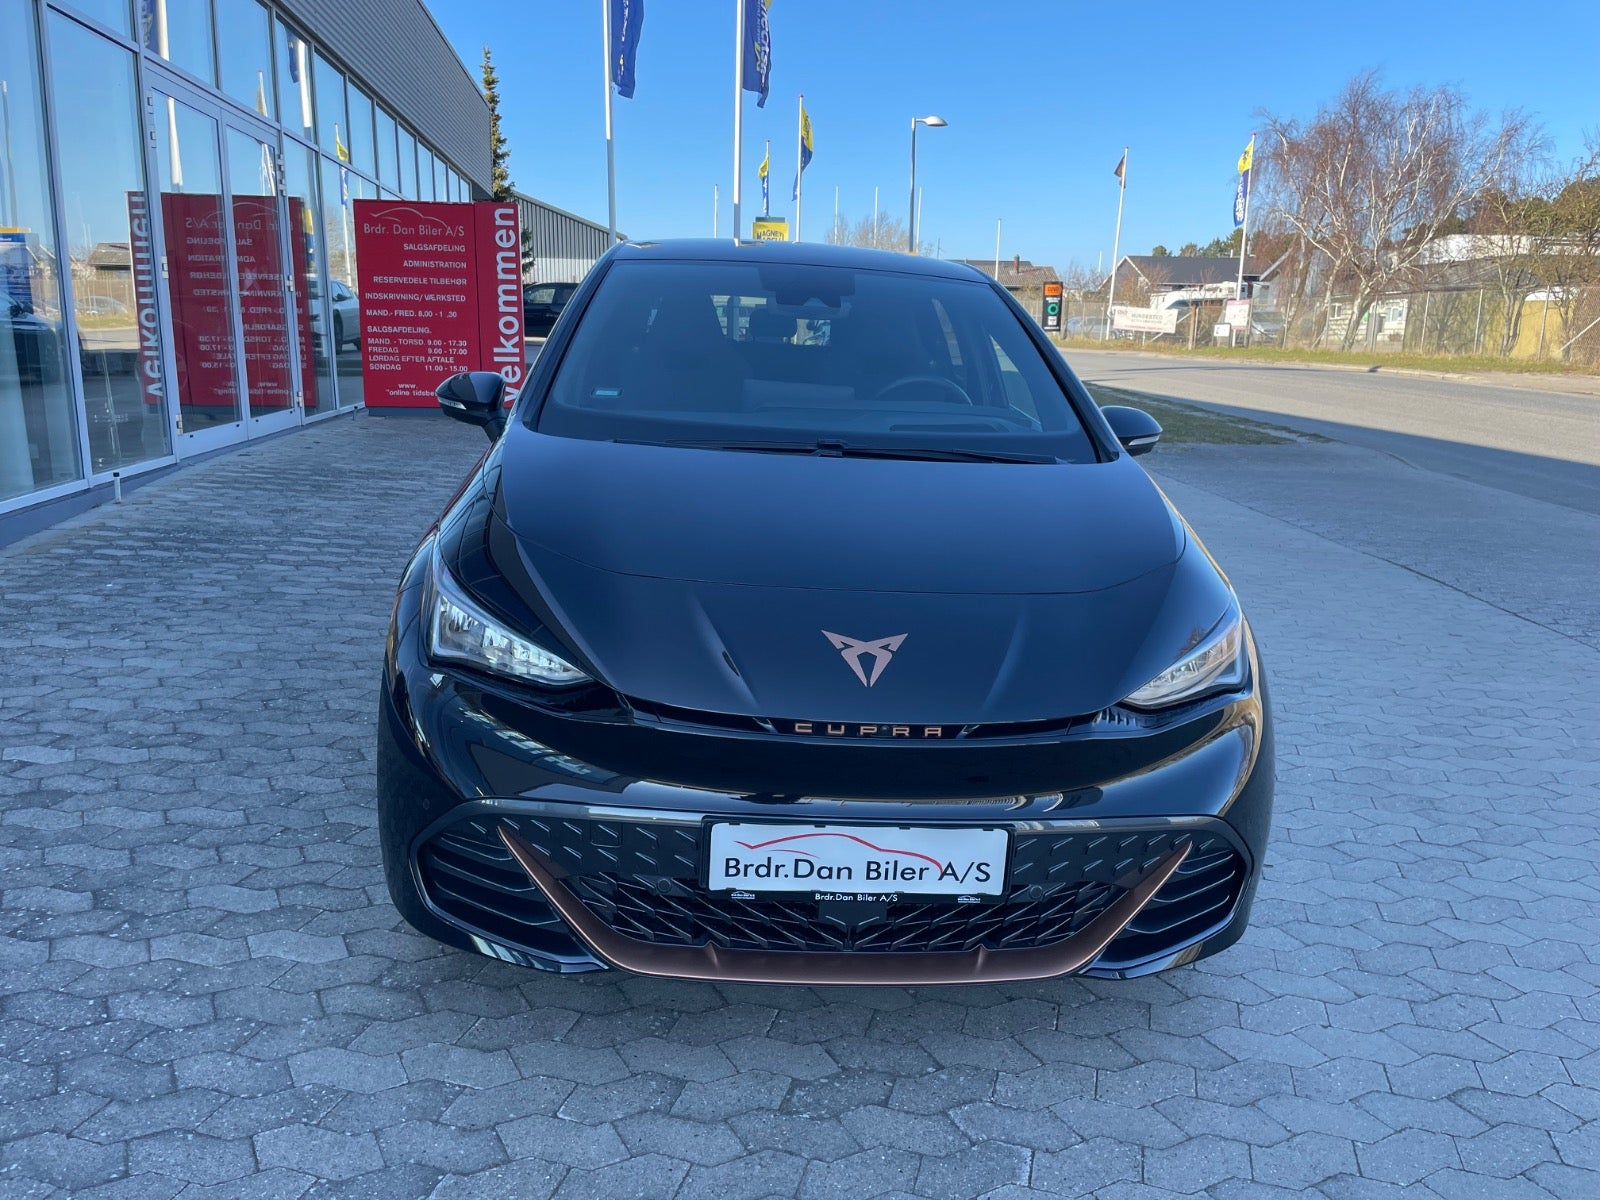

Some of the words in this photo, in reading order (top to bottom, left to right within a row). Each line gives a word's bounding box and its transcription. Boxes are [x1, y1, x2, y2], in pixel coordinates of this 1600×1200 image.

[363, 223, 390, 234] Brdr.
[393, 224, 415, 234] Dan
[419, 224, 442, 236] Biler
[445, 225, 465, 237] A/S
[403, 243, 466, 252] SALGSAFDELING
[403, 260, 467, 269] ADMINISTRATION
[373, 276, 428, 284] RESERVEDELE
[430, 278, 467, 286] TILBEHØR
[494, 207, 521, 407] velkommen
[794, 722, 942, 737] CUPRA
[865, 860, 930, 881] Biler
[937, 861, 991, 884] A/S
[857, 894, 876, 902] Biler
[880, 894, 898, 902] A/S
